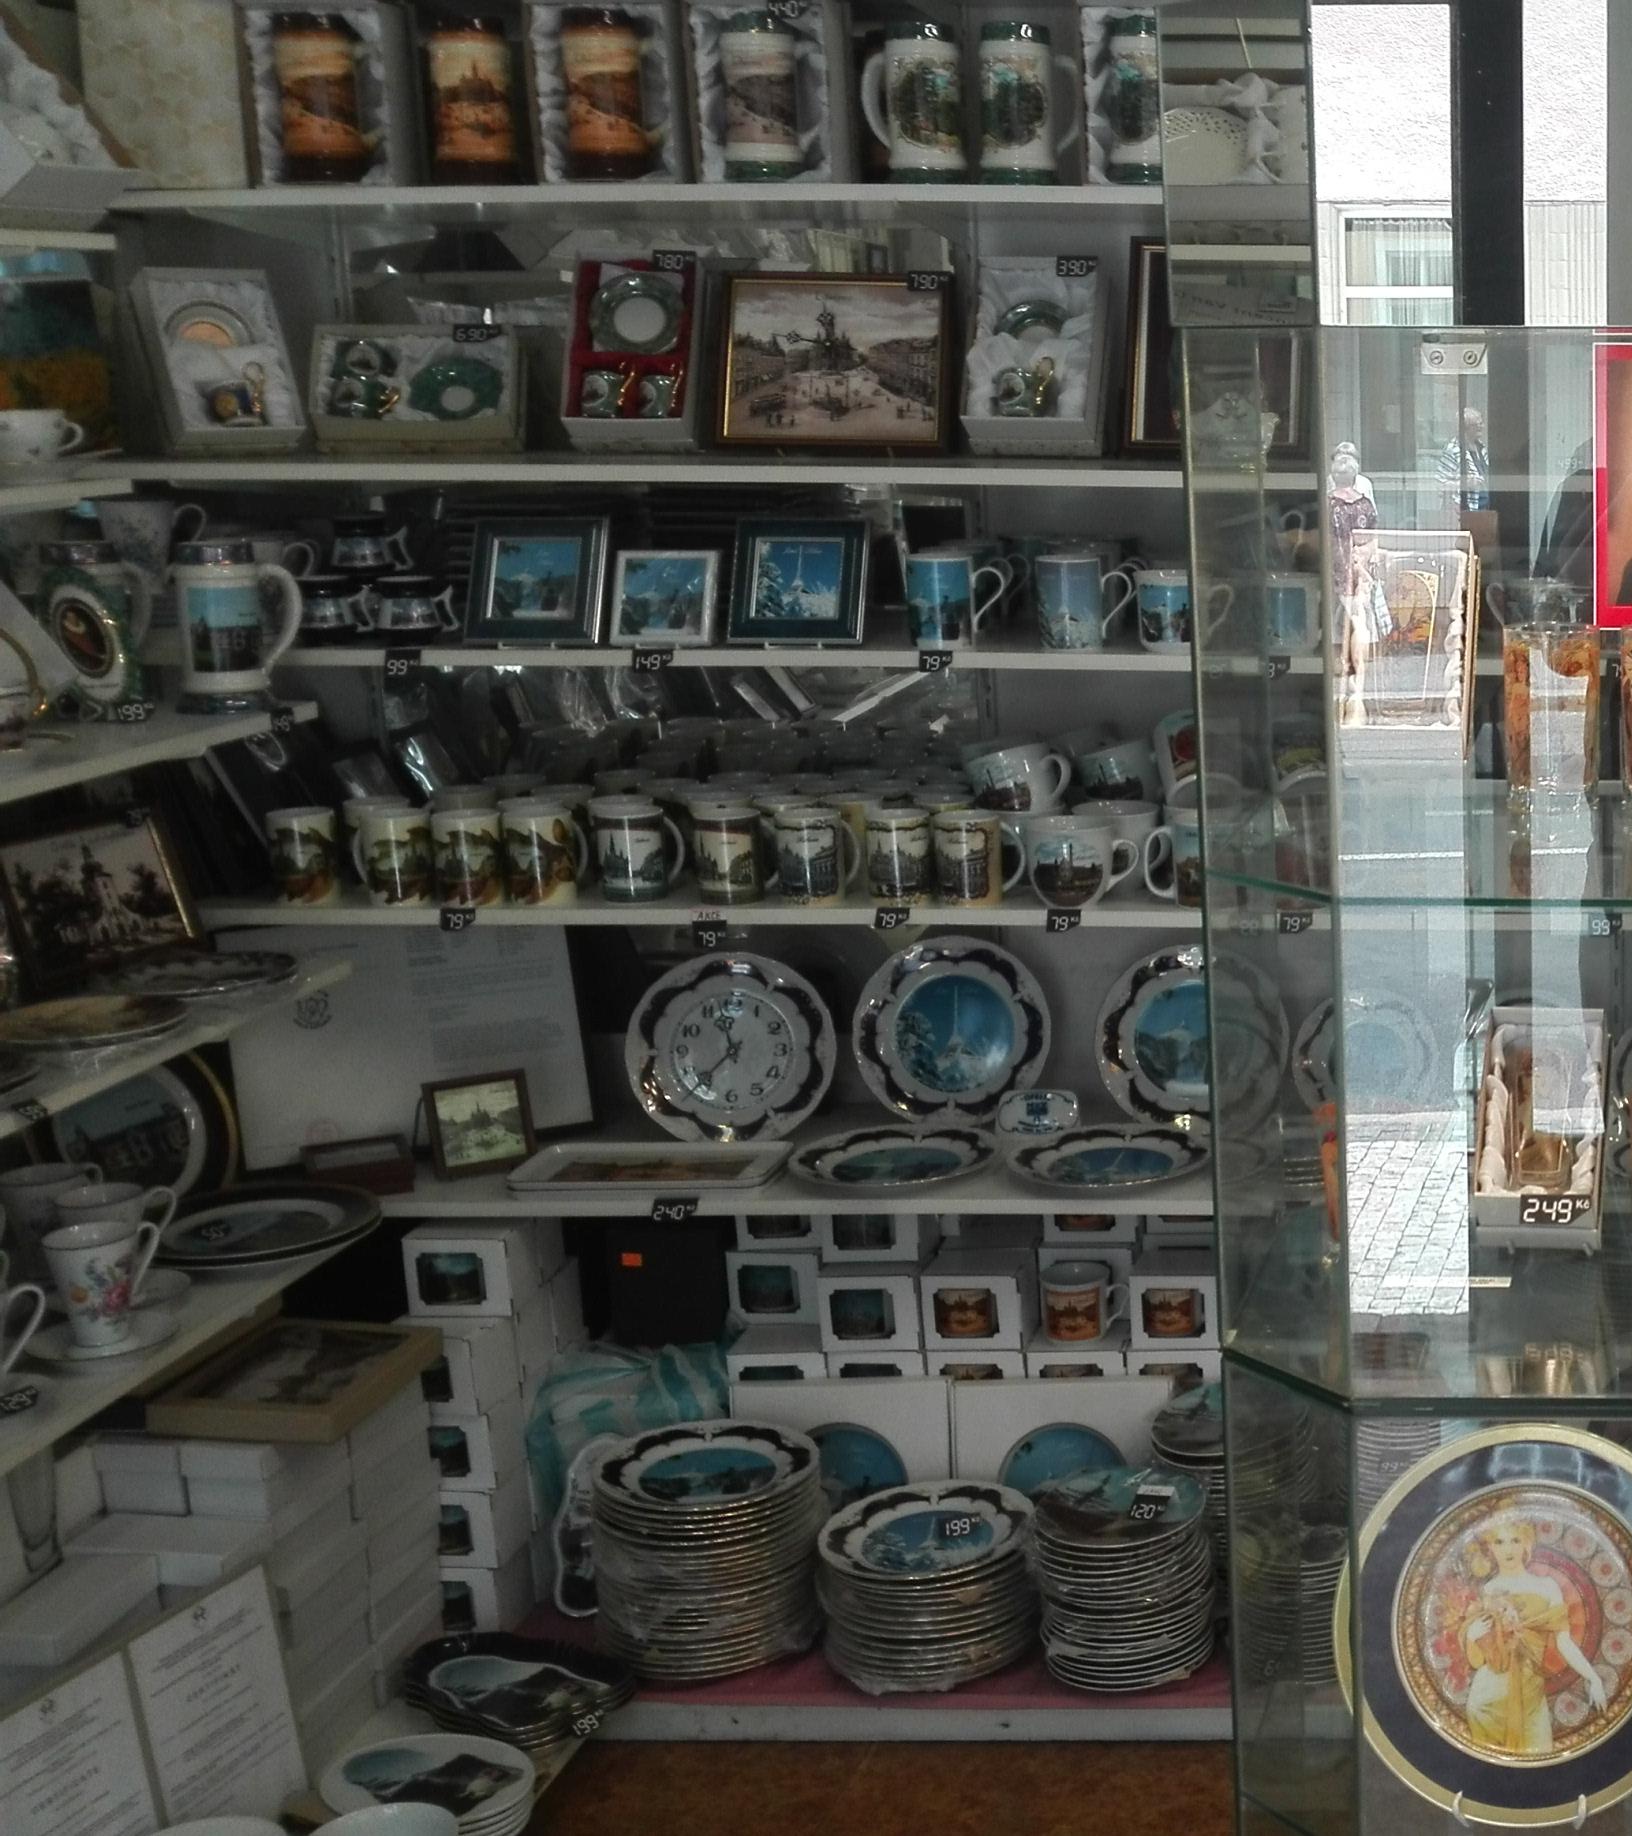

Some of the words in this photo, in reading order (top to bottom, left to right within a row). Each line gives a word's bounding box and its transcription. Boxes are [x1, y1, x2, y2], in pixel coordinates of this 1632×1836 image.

[656, 254, 683, 269] 780
[1059, 260, 1086, 275] 390
[911, 274, 938, 289] 790
[456, 328, 486, 341] 690
[387, 659, 408, 675] 99
[636, 654, 661, 670] 149
[923, 656, 940, 670] 79
[117, 703, 145, 720] 199
[448, 913, 463, 929] 79
[880, 913, 896, 929] 79
[1052, 916, 1068, 931] 79
[1283, 916, 1300, 932] 79
[1592, 920, 1610, 935] 99
[698, 931, 716, 947] 79
[682, 1024, 701, 1037] 10
[768, 1021, 782, 1035] 2
[773, 1043, 787, 1057] 3
[766, 1066, 780, 1079] 4
[725, 1090, 738, 1103] 6
[750, 1083, 764, 1096] 5
[654, 1205, 685, 1221] 240
[1523, 1199, 1573, 1224] 249
[1131, 1504, 1157, 1519] 120
[946, 1517, 970, 1536] 199
[572, 1715, 599, 1736] 199
